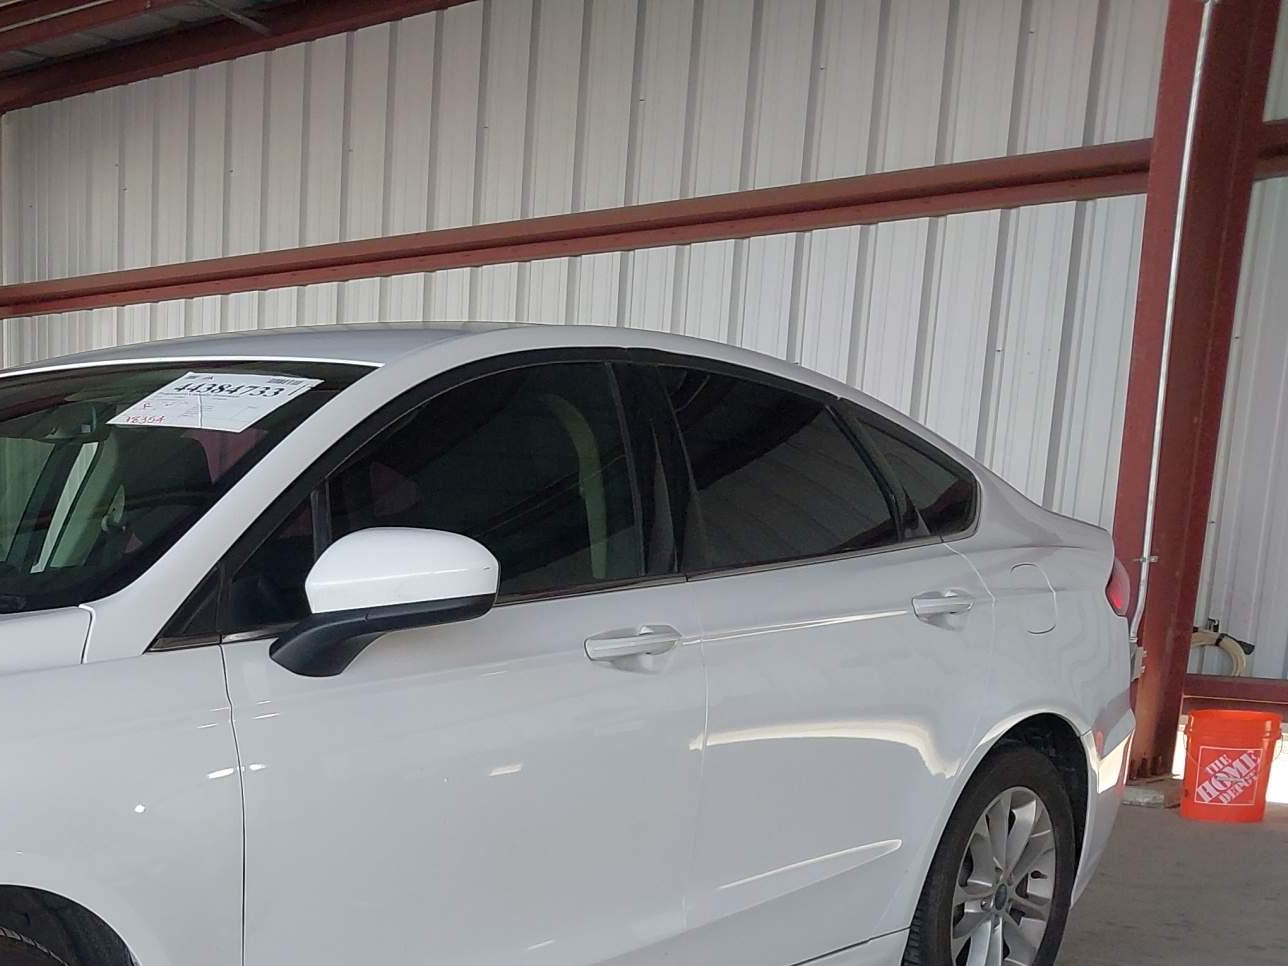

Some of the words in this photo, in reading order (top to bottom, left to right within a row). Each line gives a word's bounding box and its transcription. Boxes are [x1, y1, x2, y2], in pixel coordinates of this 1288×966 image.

[174, 383, 285, 397] 44384733
[1196, 750, 1260, 802] HOME
[1206, 754, 1231, 775] THE
[1219, 770, 1257, 803] DEPOT
